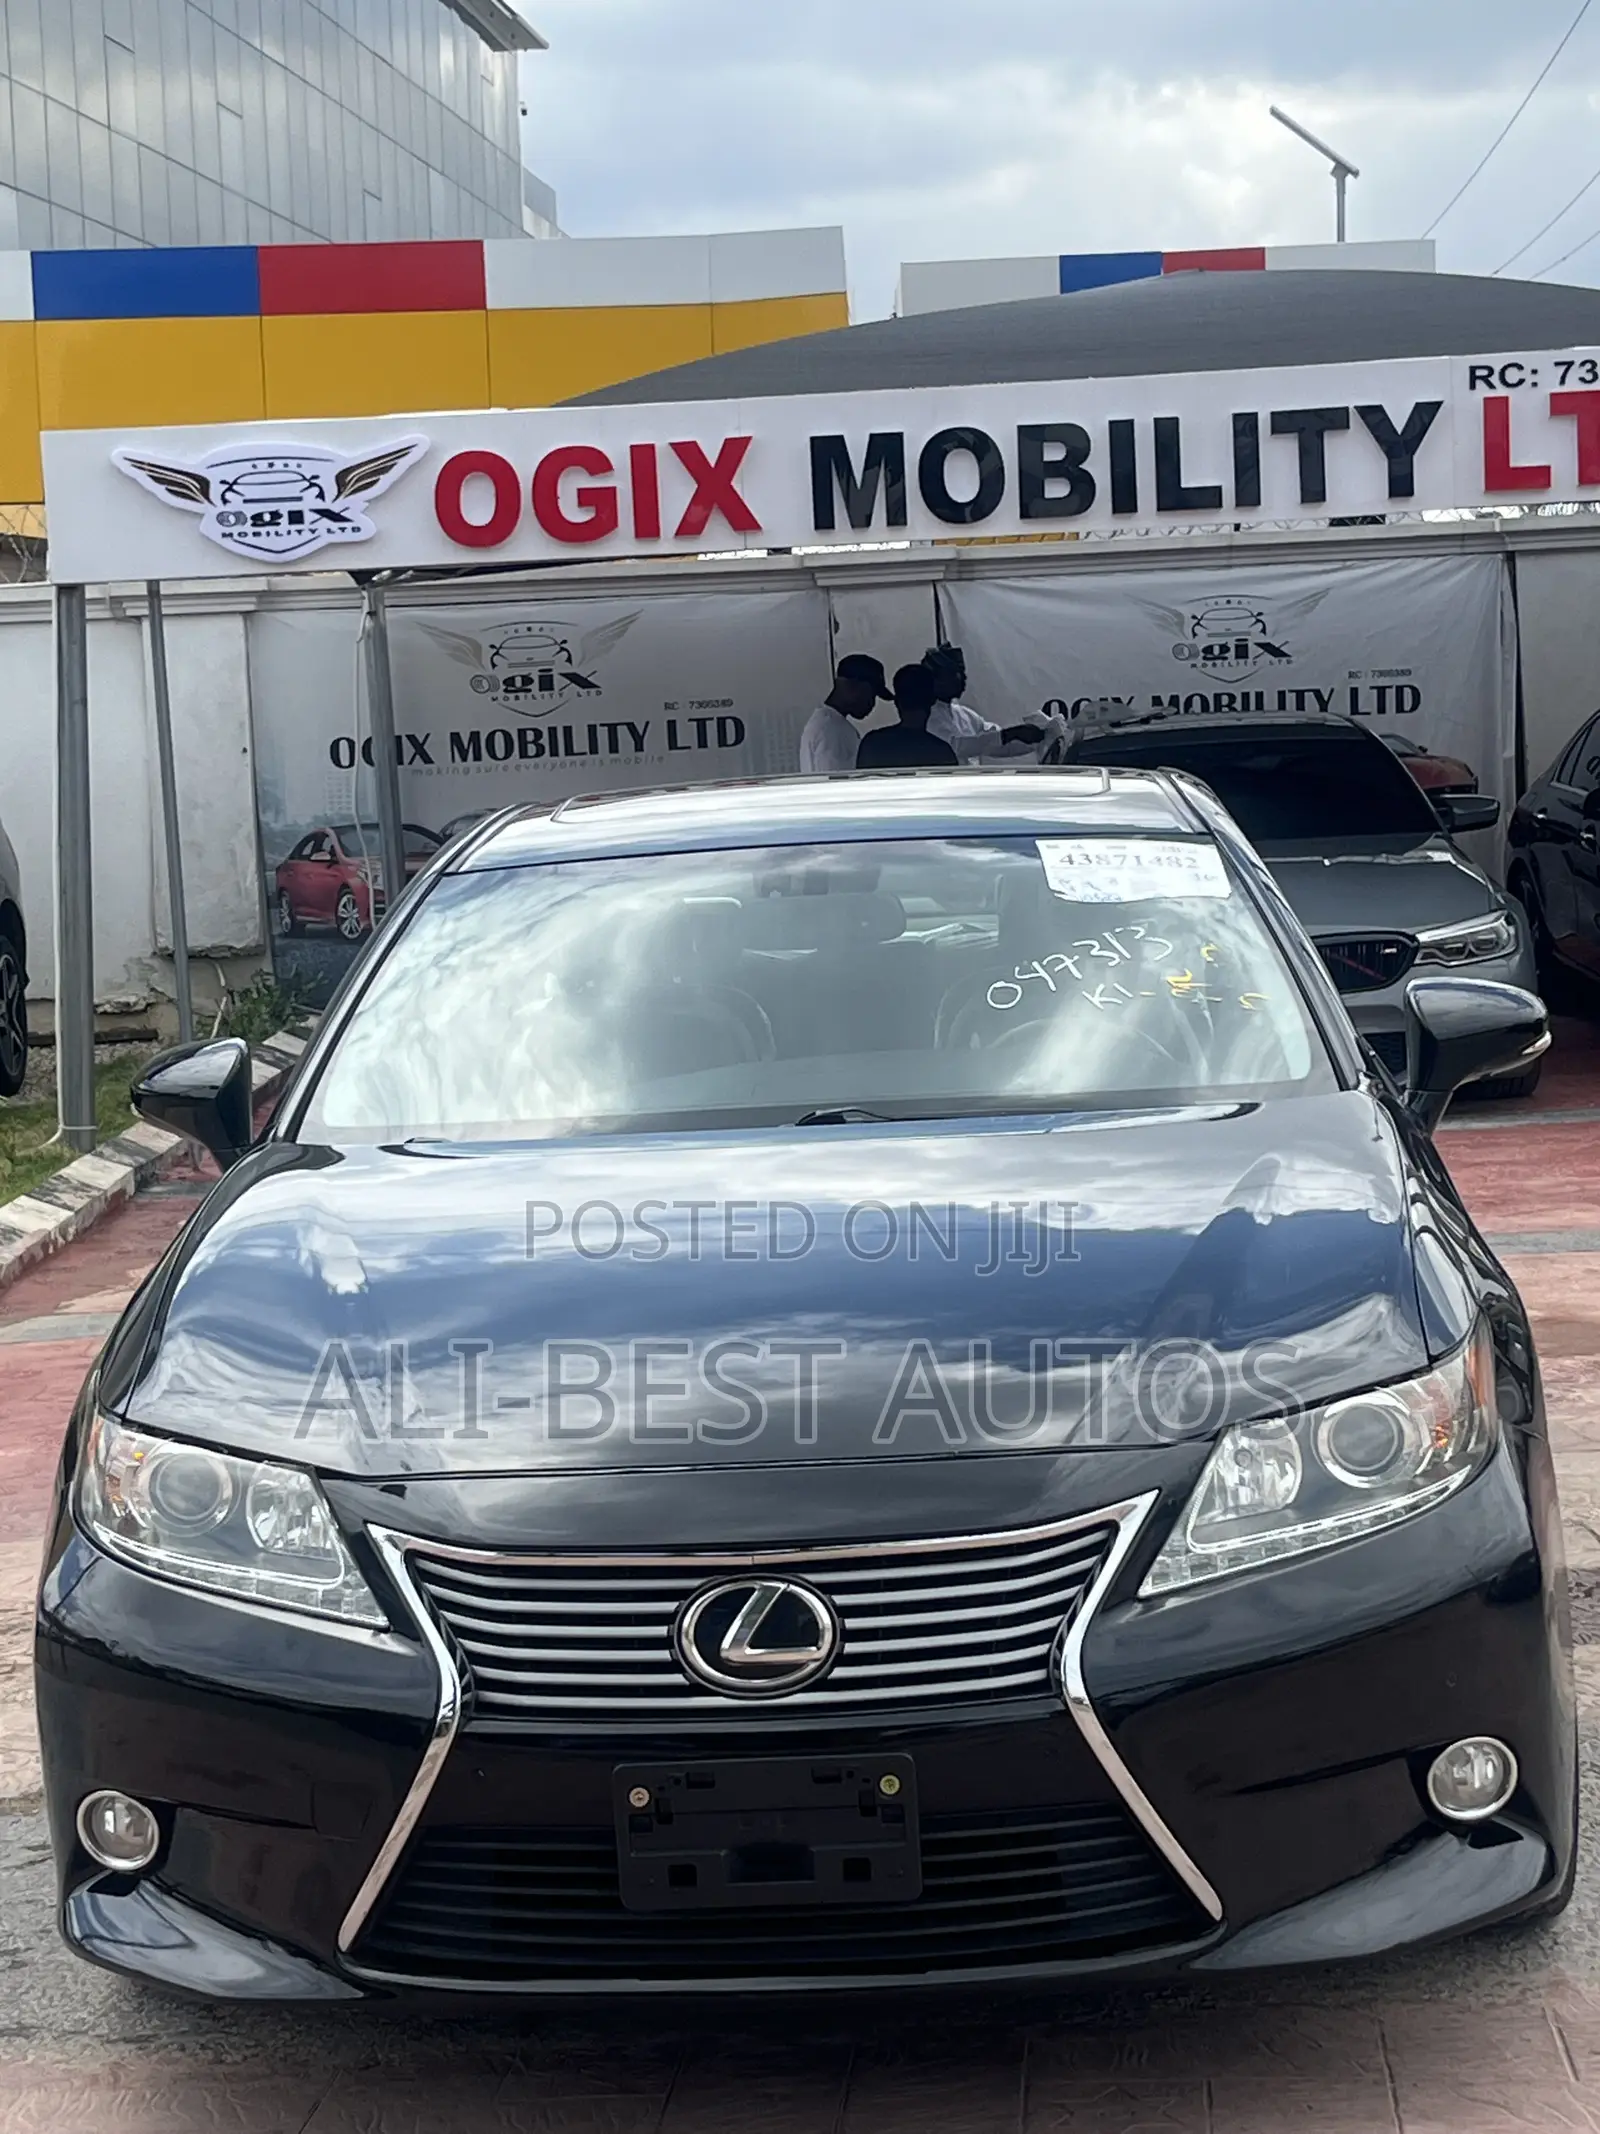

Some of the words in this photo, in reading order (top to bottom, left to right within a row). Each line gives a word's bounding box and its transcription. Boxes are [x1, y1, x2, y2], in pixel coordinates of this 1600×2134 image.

[1468, 362, 1539, 391] RC:
[434, 436, 764, 549] OGIX
[810, 400, 1444, 531] MOBILITY
[221, 528, 319, 538] MOBILITY
[326, 526, 362, 535] LTD
[1349, 684, 1421, 716] LTD
[450, 720, 650, 763] MOBILITY
[667, 715, 745, 751] LTD
[475, 762, 509, 774] sure
[514, 758, 587, 773] everyone
[610, 753, 665, 766] mobile
